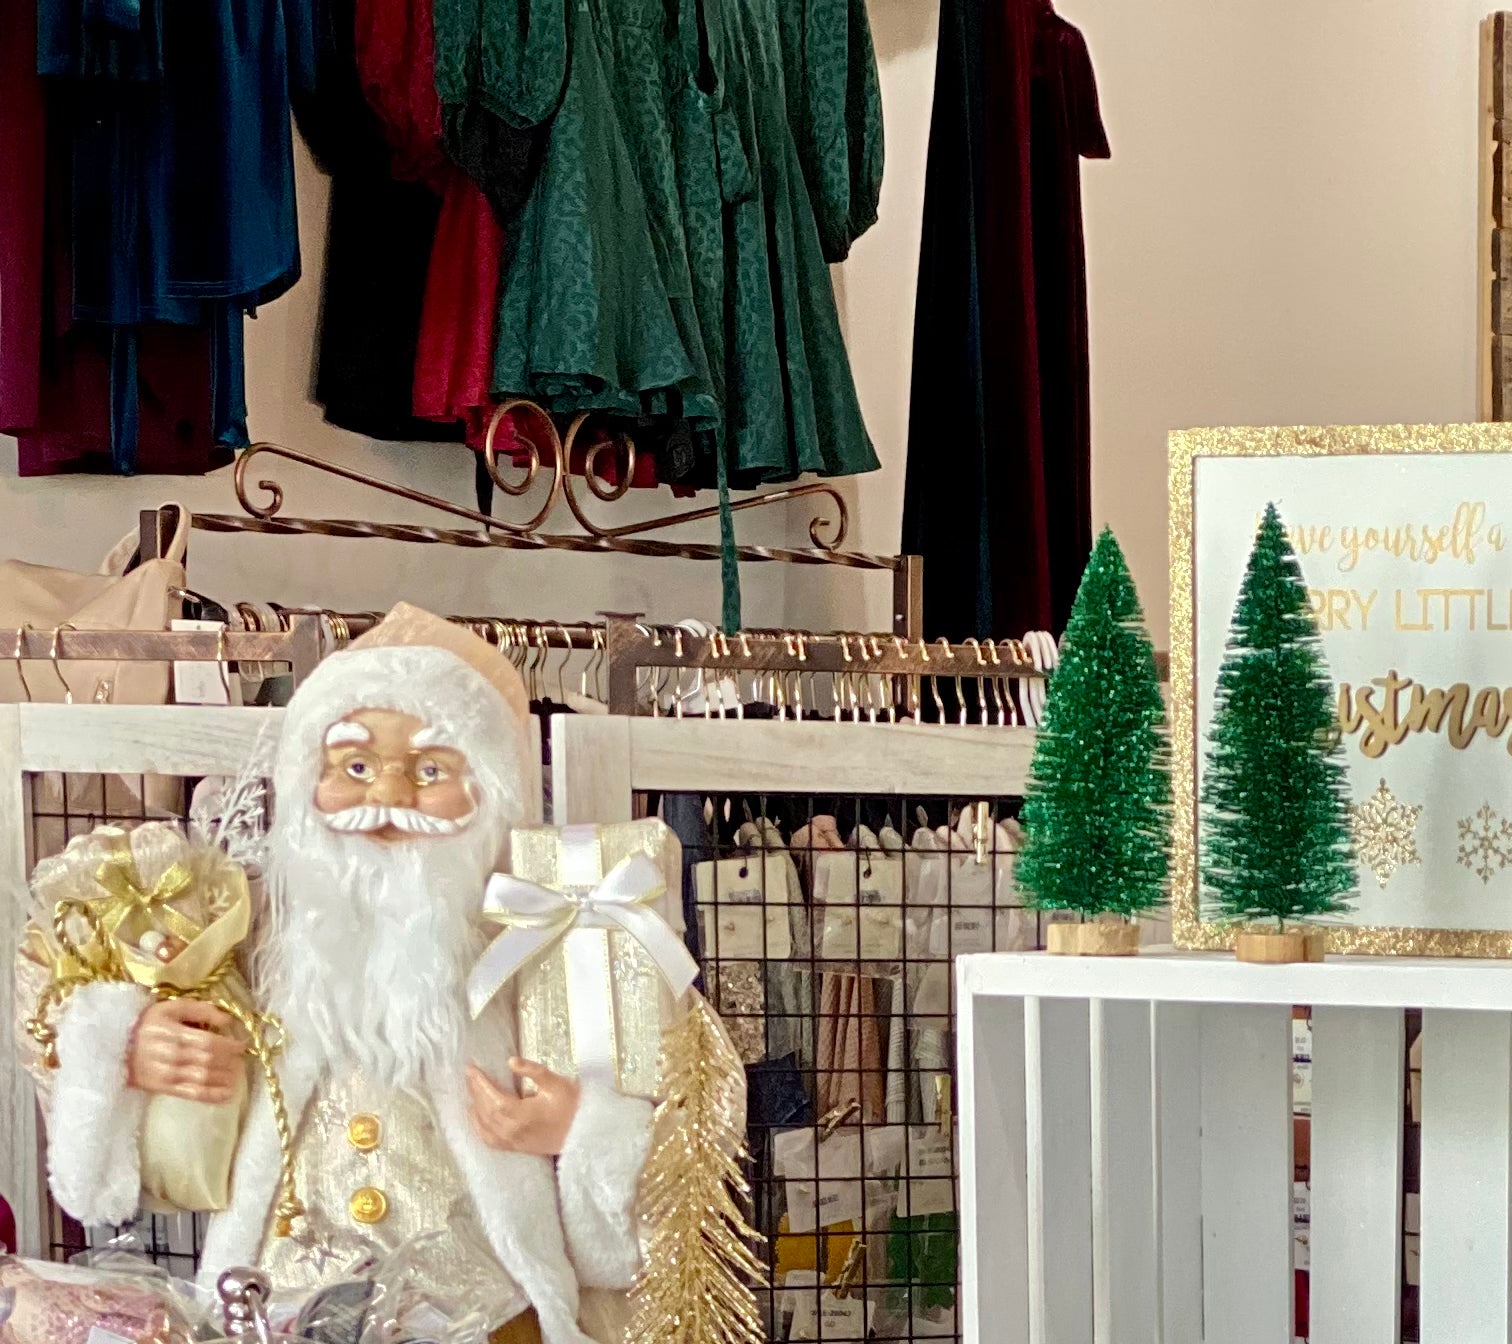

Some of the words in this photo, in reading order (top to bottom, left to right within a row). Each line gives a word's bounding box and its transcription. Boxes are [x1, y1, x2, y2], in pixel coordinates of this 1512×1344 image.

[1337, 500, 1486, 572] yourself
[1487, 522, 1511, 551] a
[1302, 588, 1378, 632] RRY
